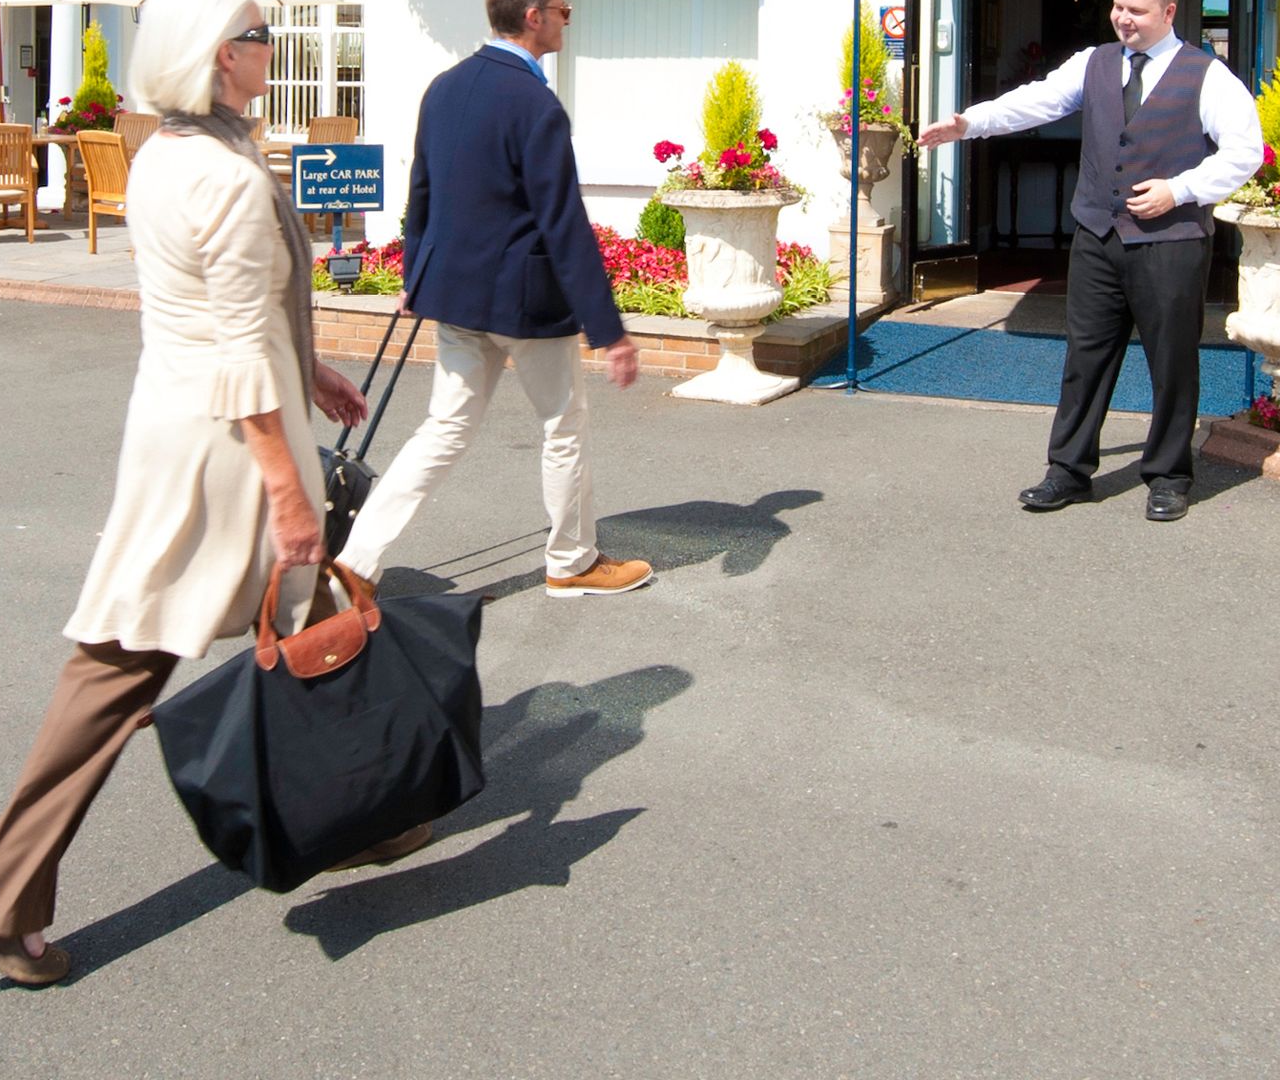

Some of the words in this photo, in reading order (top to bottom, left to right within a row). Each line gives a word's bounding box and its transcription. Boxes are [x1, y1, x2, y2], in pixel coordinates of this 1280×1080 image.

[302, 170, 328, 183] Large
[330, 169, 352, 180] CAR
[354, 168, 381, 180] PARK
[306, 186, 316, 195] at
[318, 186, 337, 195] rear
[339, 183, 350, 195] of
[352, 183, 377, 195] Hotel
